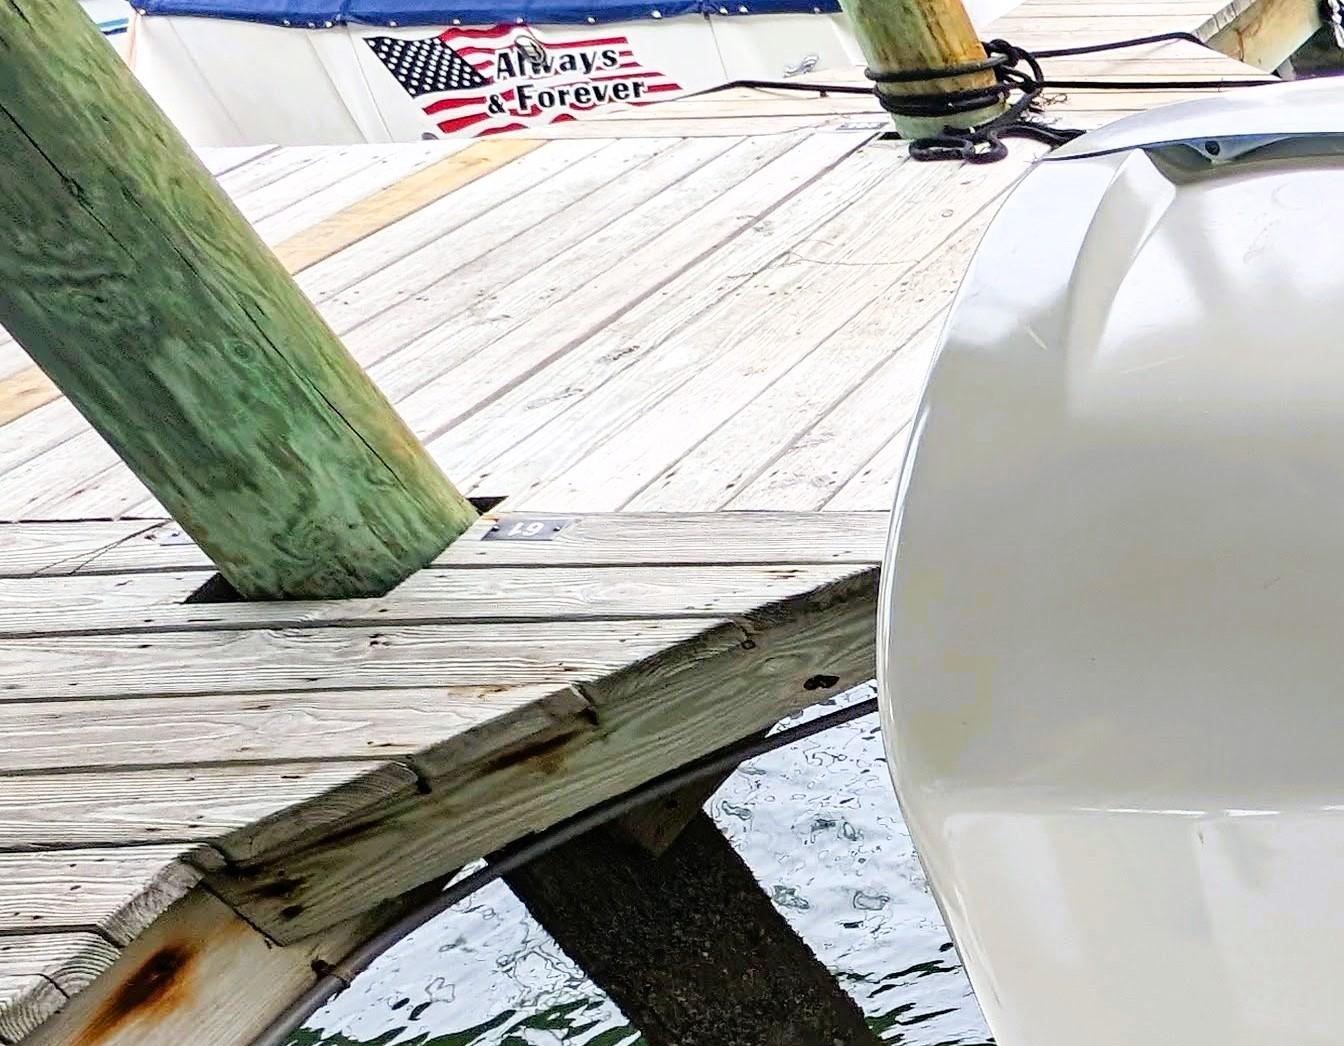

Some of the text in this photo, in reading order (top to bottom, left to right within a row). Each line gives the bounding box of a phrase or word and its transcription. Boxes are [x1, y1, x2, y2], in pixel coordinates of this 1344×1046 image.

[496, 49, 618, 80] Always
[487, 80, 645, 115] & Forever
